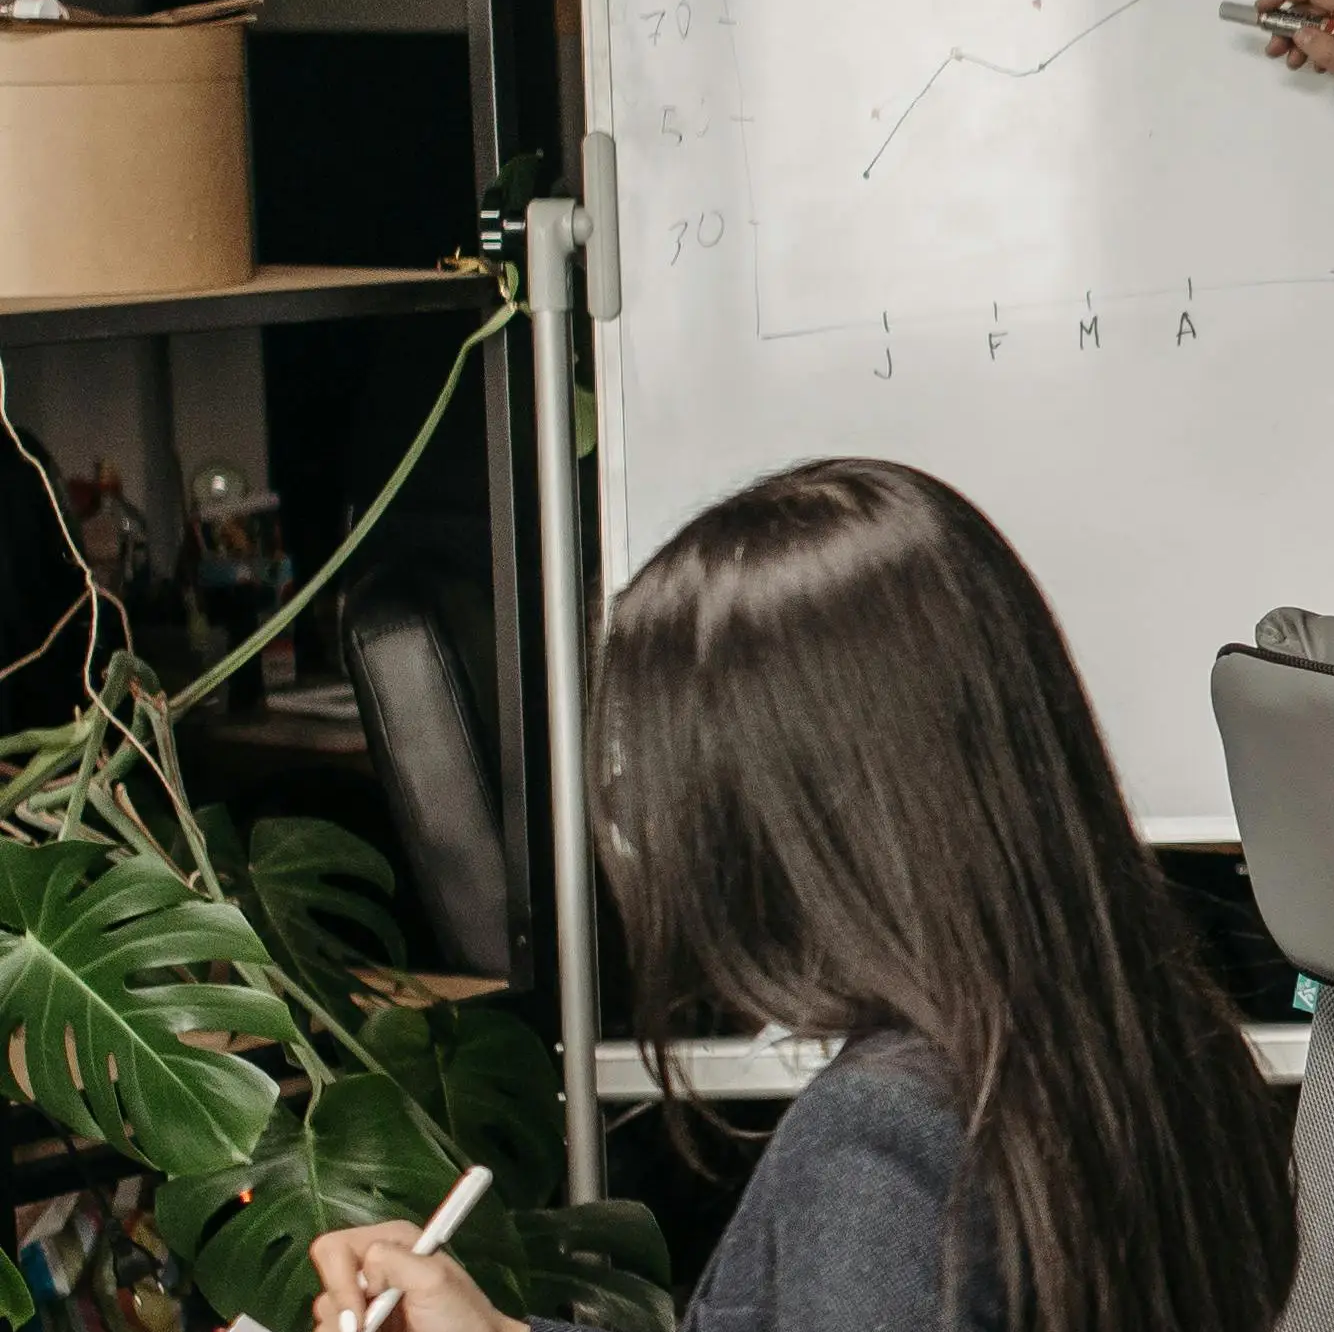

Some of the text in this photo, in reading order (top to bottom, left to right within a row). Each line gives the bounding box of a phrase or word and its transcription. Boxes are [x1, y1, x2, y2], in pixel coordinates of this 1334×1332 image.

[873, 310, 1199, 380] J F M A
